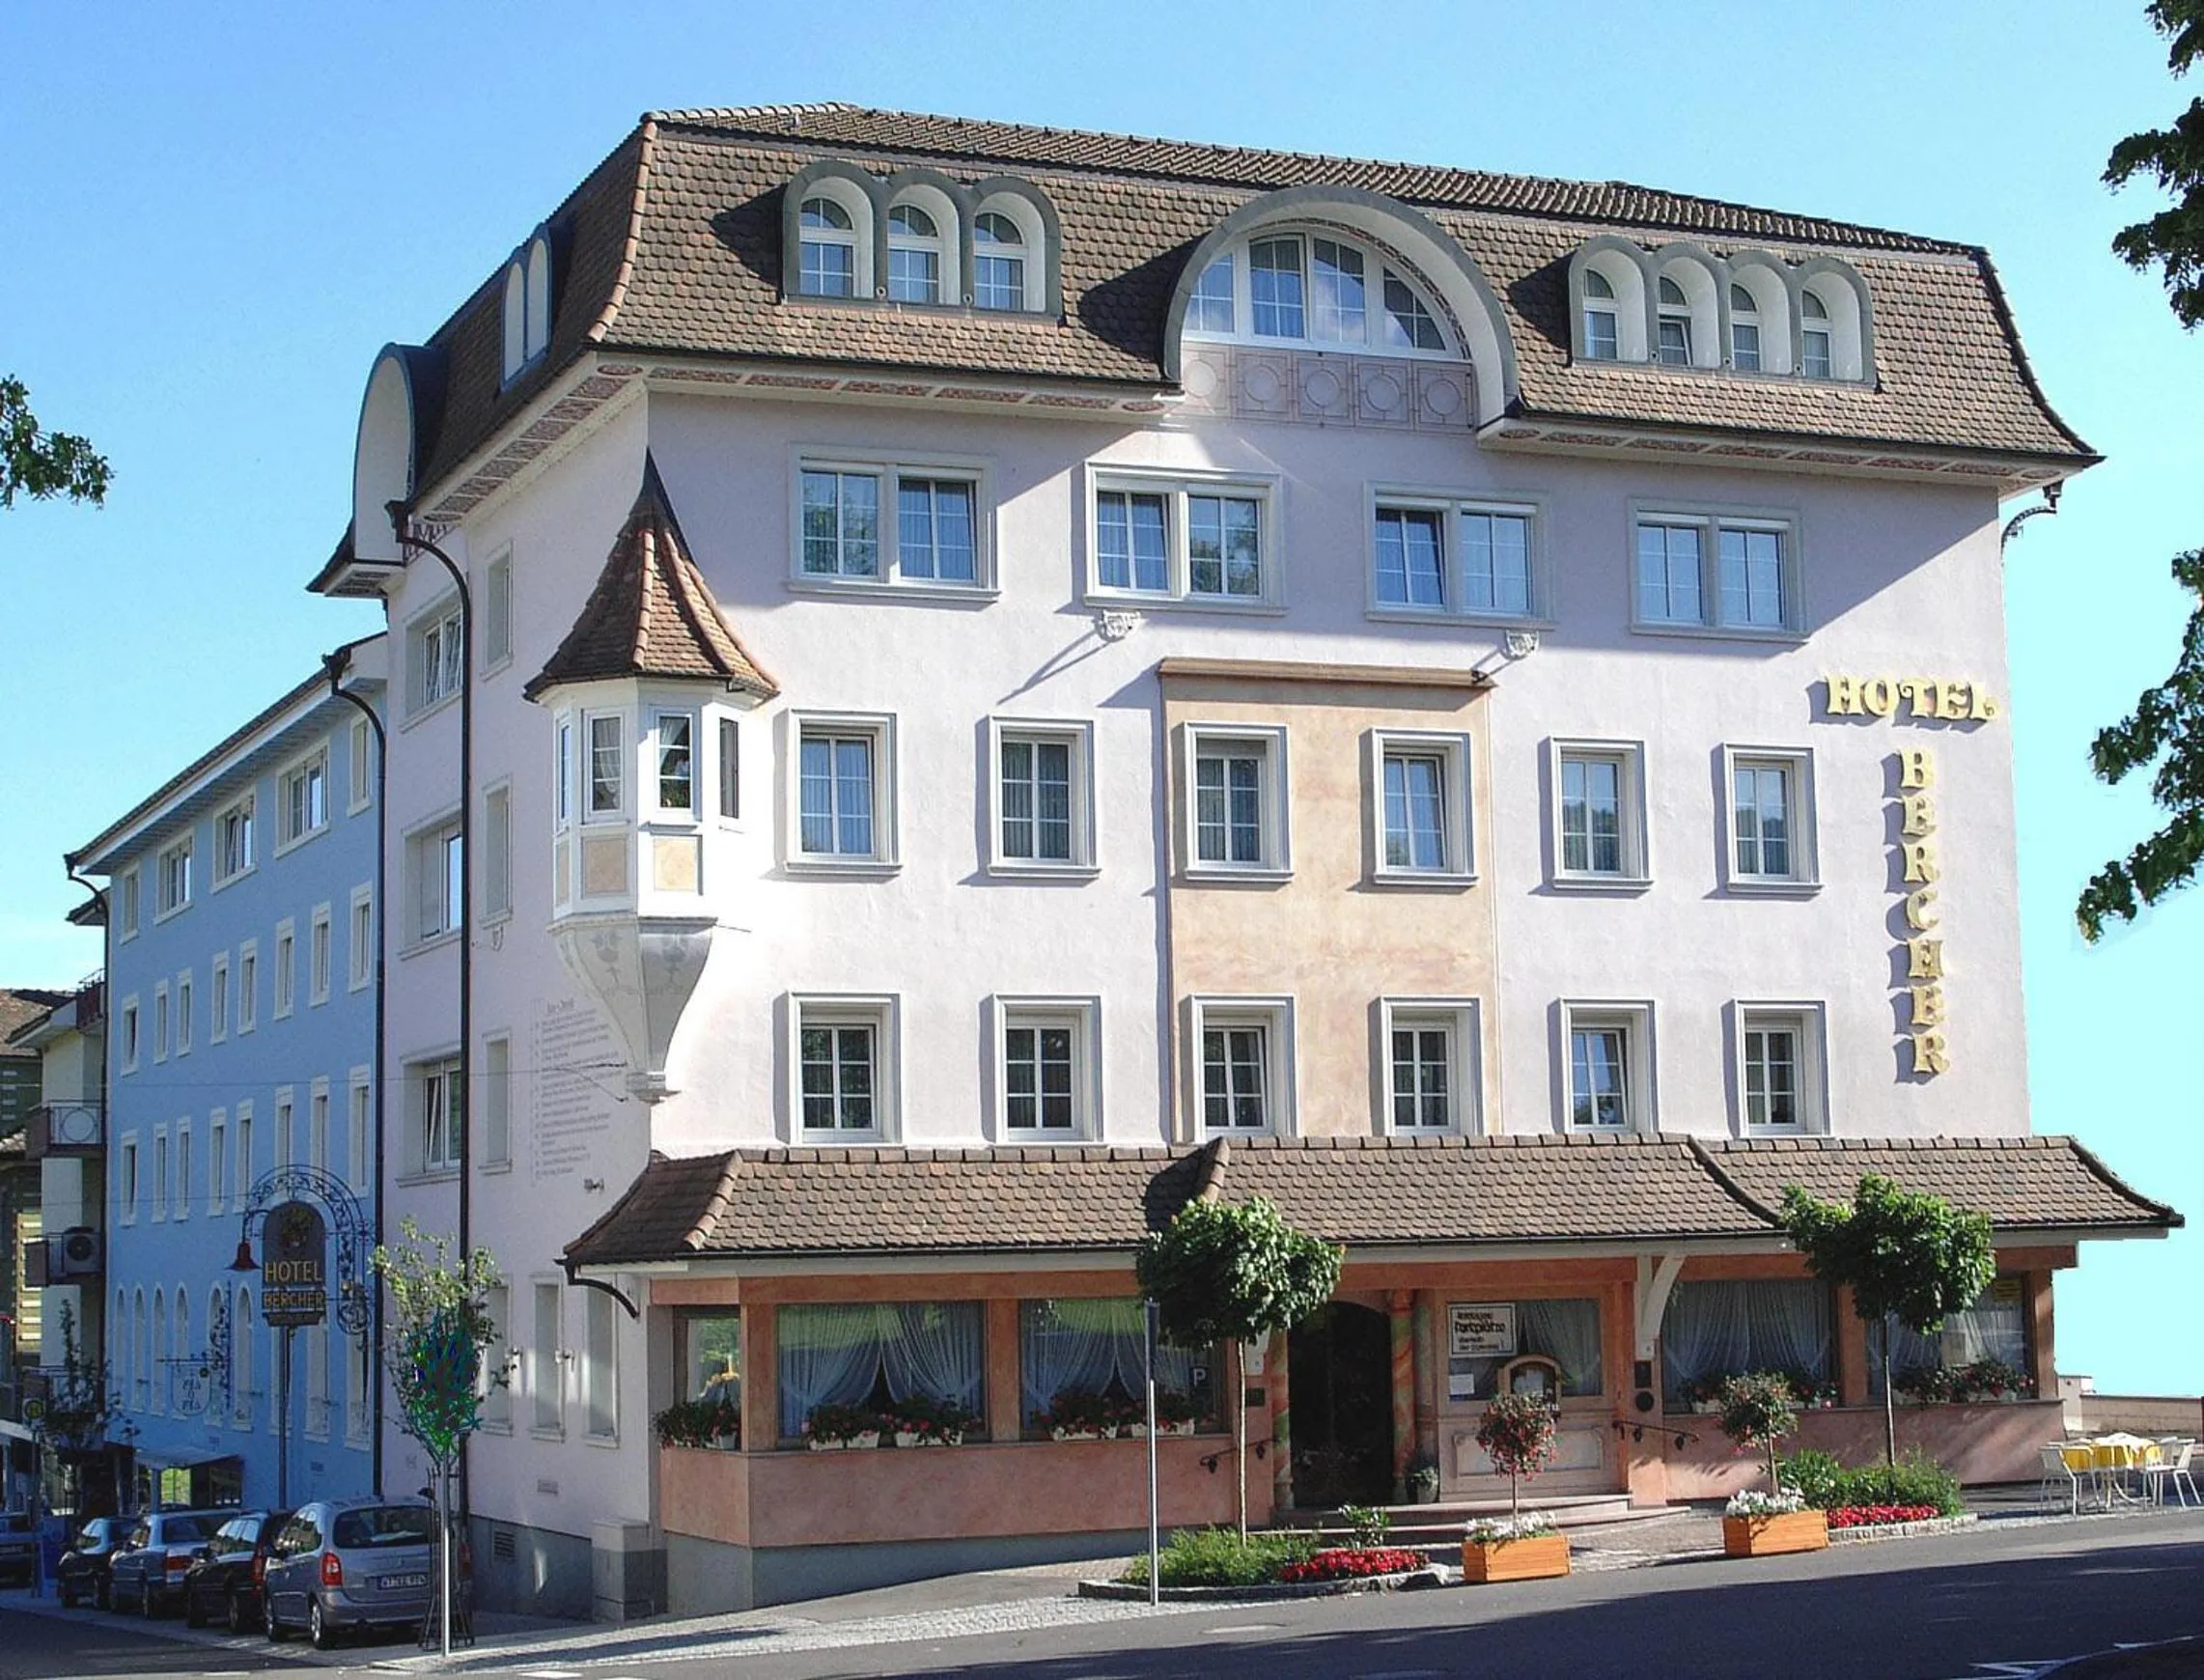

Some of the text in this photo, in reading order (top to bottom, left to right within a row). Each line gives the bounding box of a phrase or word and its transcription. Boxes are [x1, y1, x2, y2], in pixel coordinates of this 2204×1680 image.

[1825, 675, 1999, 721] HOTEL
[1899, 748, 1950, 1075] BERCHER
[264, 1260, 323, 1282] HOTEL
[264, 1291, 324, 1309] BERCHER
[1193, 1367, 1206, 1386] P
